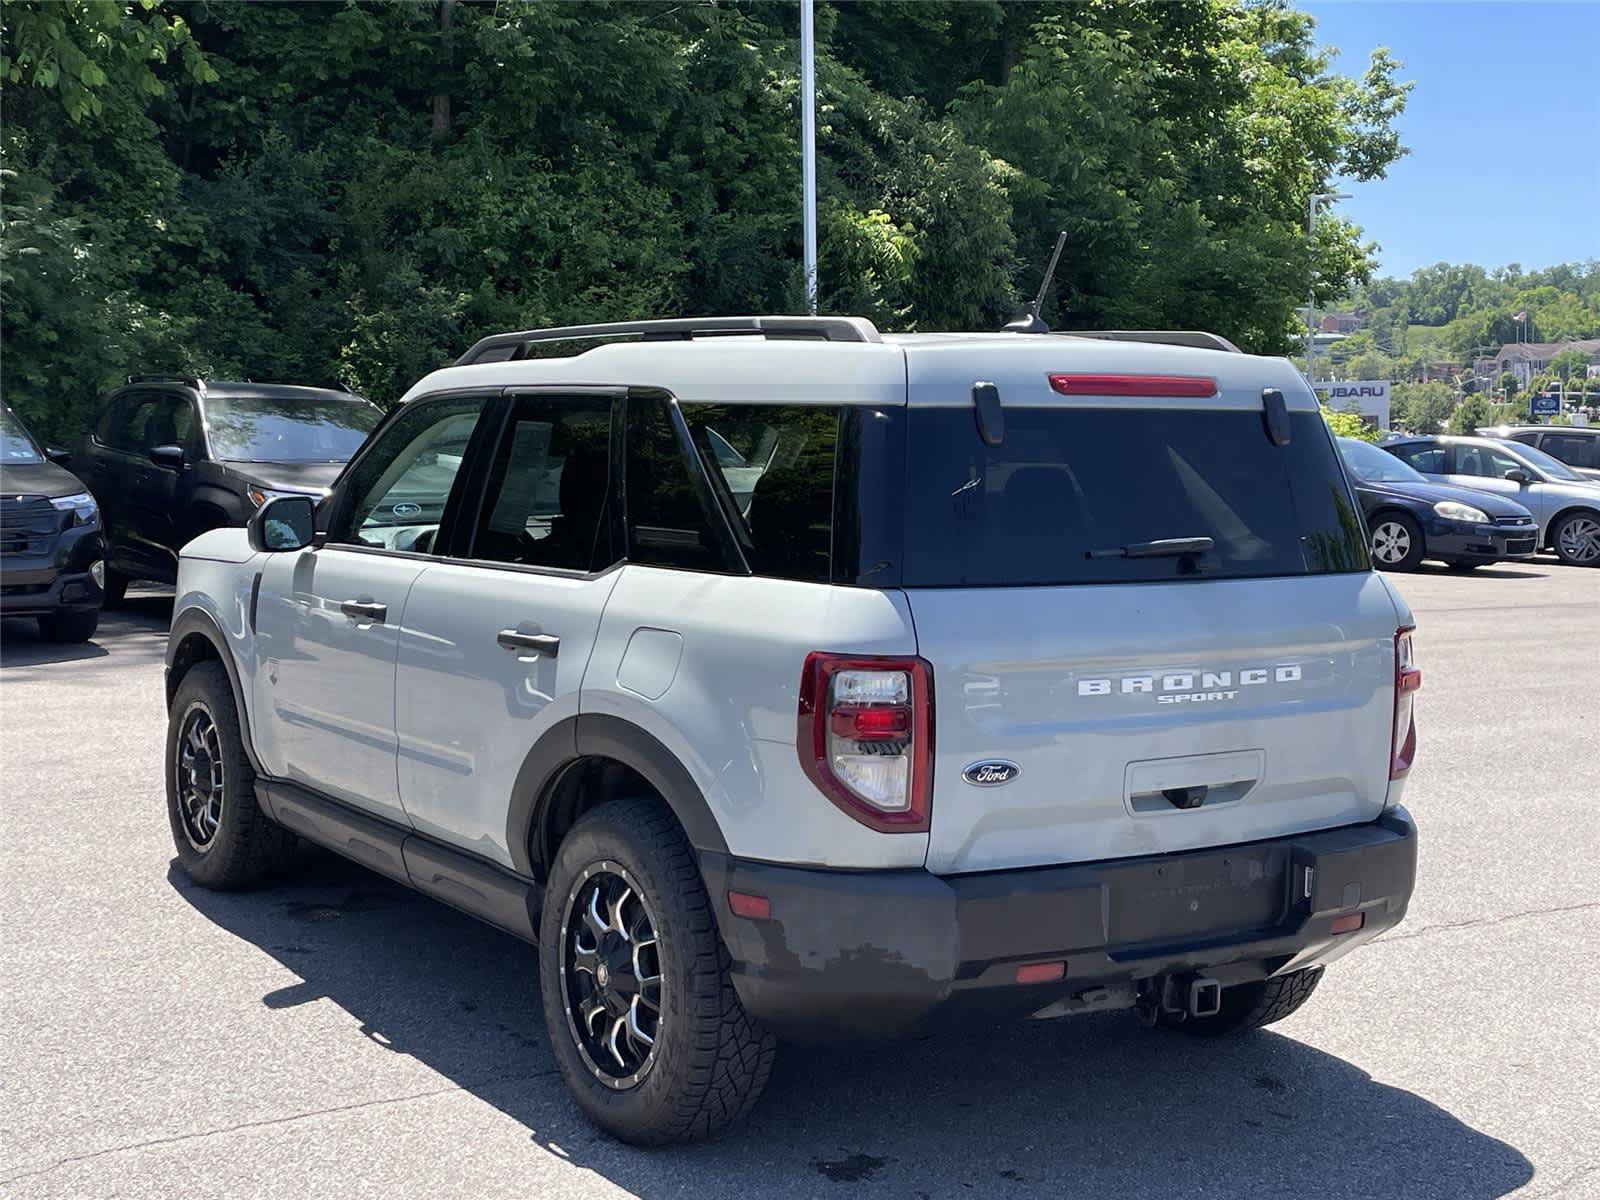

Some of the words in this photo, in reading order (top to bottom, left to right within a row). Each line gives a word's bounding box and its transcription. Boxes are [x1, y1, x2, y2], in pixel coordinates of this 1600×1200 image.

[1077, 664, 1302, 696] BRONCO
[1157, 690, 1239, 704] SPORT
[976, 765, 1010, 782] Ford
